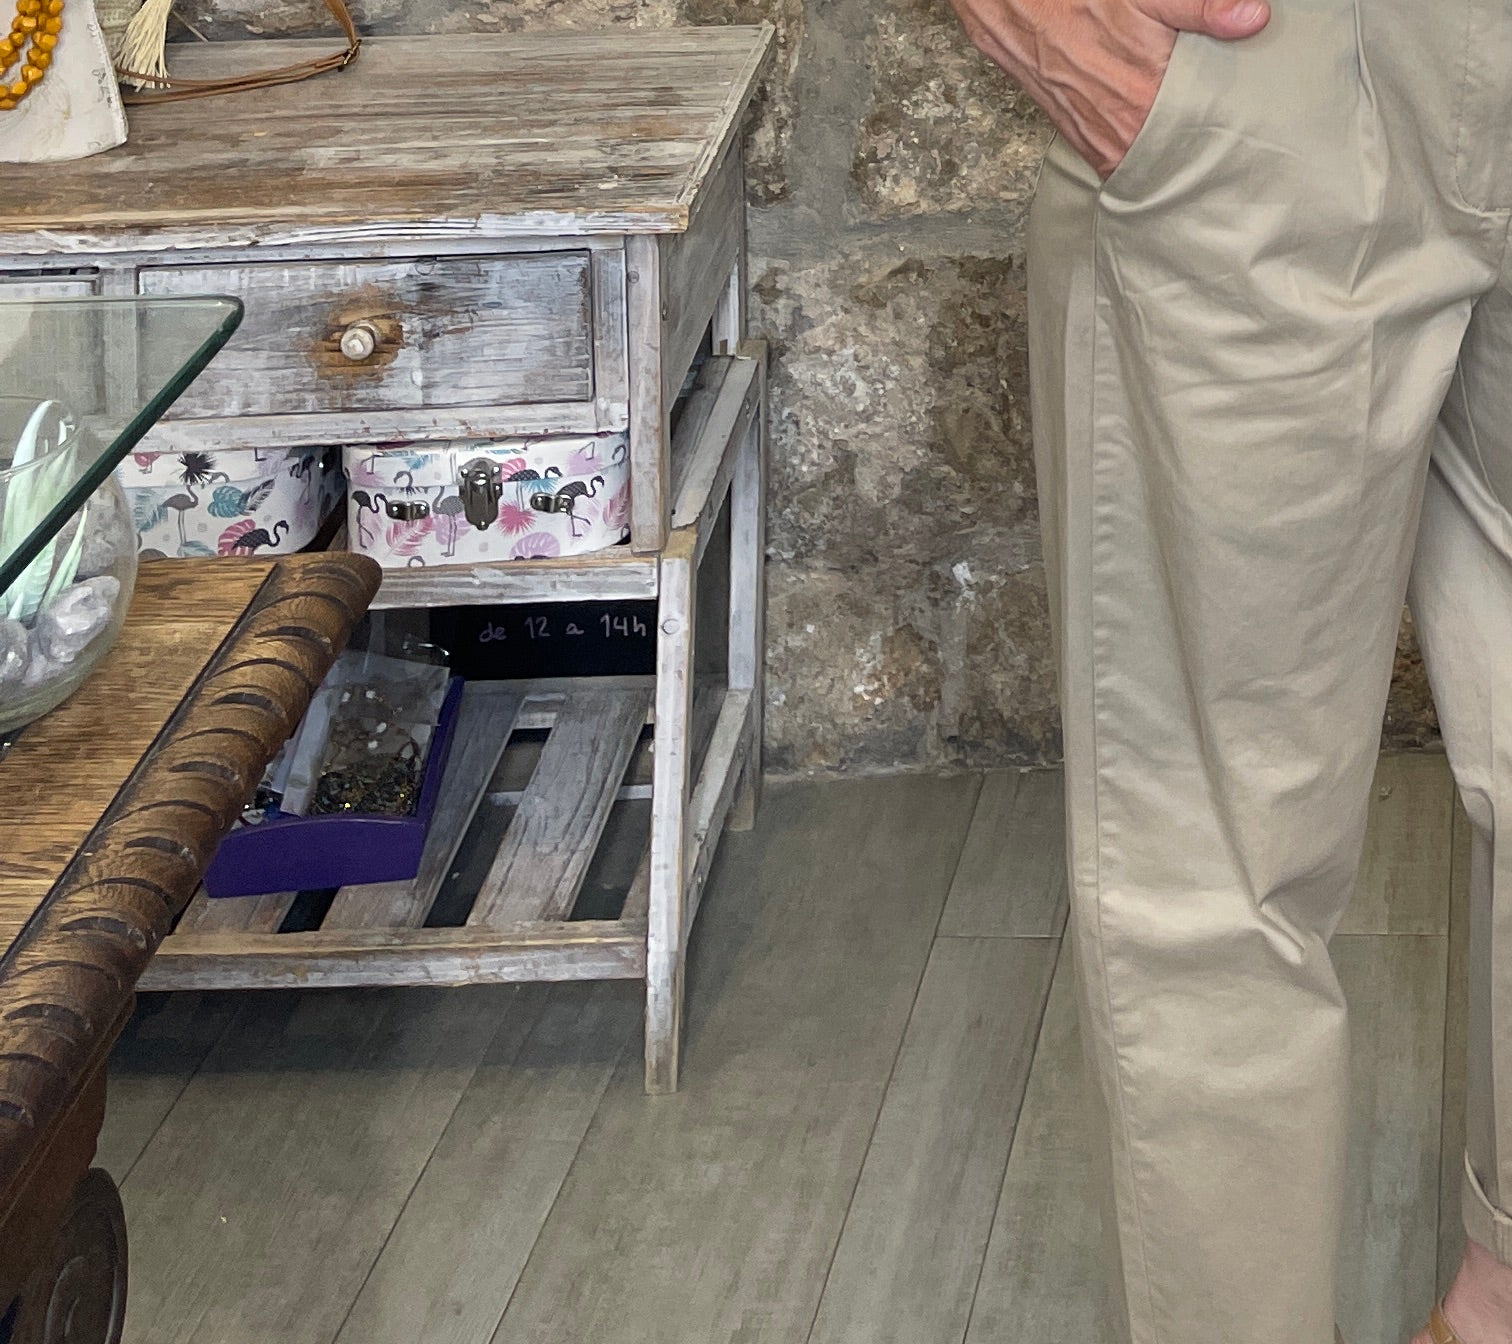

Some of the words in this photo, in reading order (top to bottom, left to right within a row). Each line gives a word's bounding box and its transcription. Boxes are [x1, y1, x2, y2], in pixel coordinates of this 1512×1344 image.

[479, 622, 507, 643] de
[524, 615, 551, 639] 12
[565, 622, 585, 636] a
[599, 613, 647, 638] 14h
